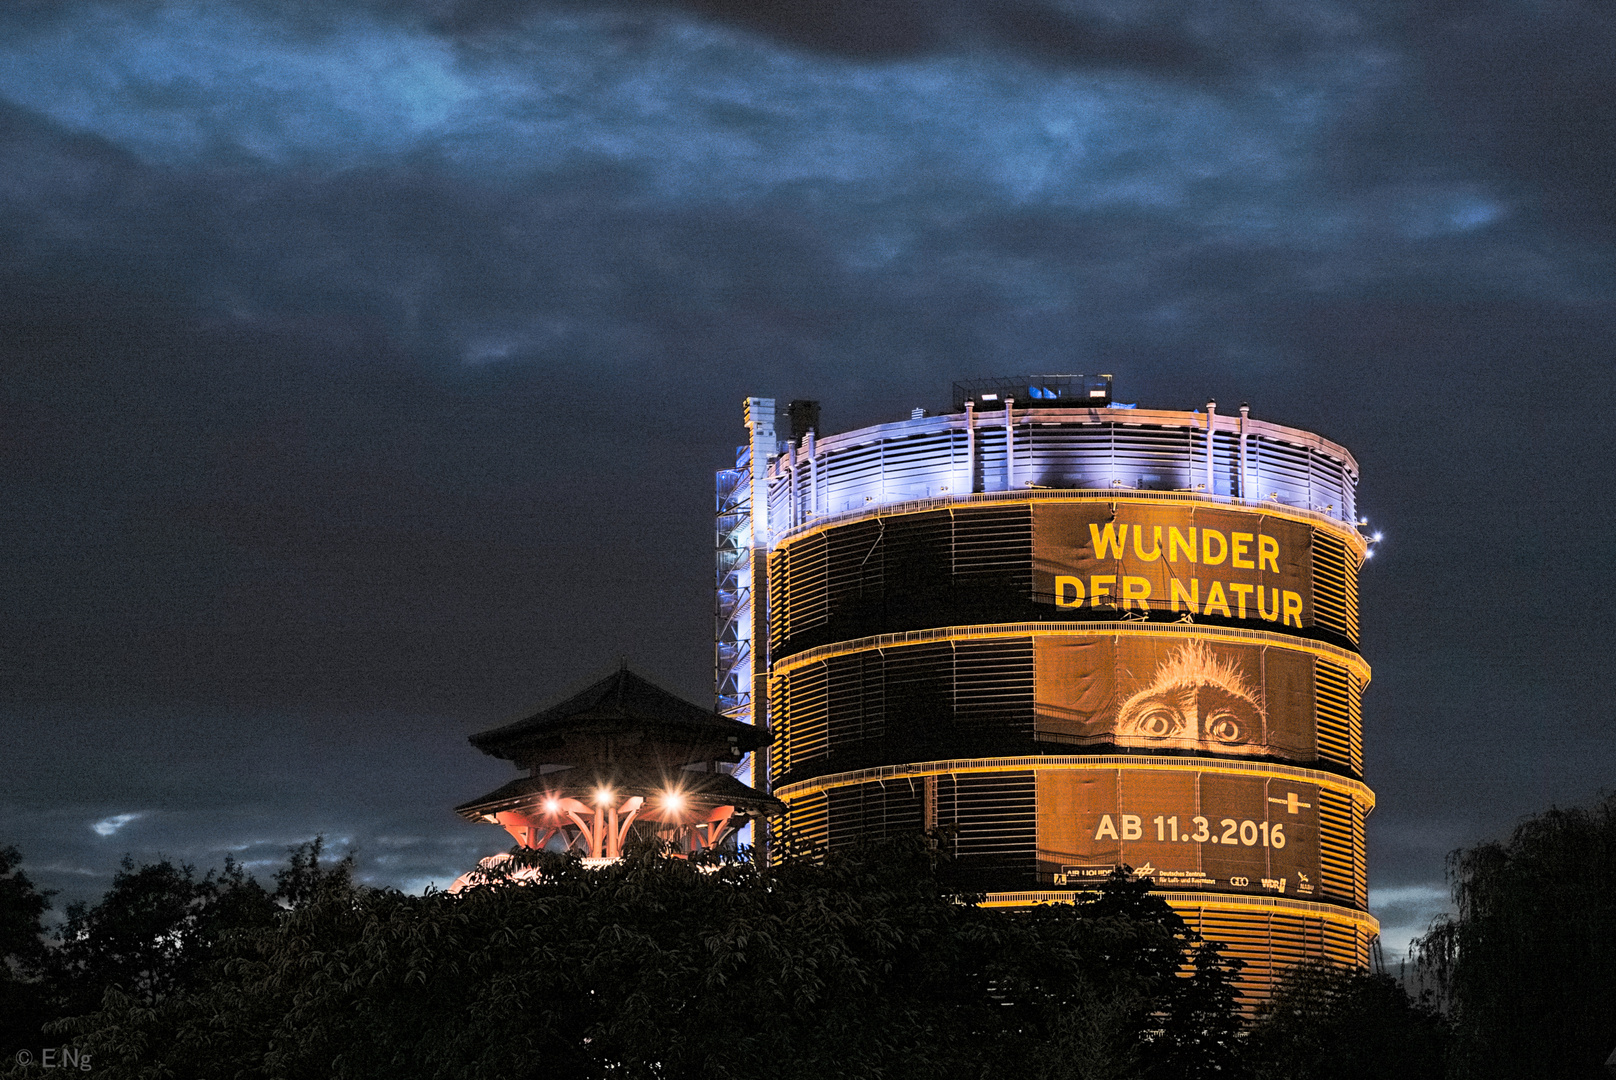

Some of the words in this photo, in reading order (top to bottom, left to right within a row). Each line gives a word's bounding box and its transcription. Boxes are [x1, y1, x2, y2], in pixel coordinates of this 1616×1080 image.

[1088, 523, 1280, 574] WUNDER
[1055, 575, 1151, 611] DER
[1170, 577, 1303, 629] NATUR
[1095, 814, 1143, 841] AB
[1154, 815, 1286, 849] 11.3.2016
